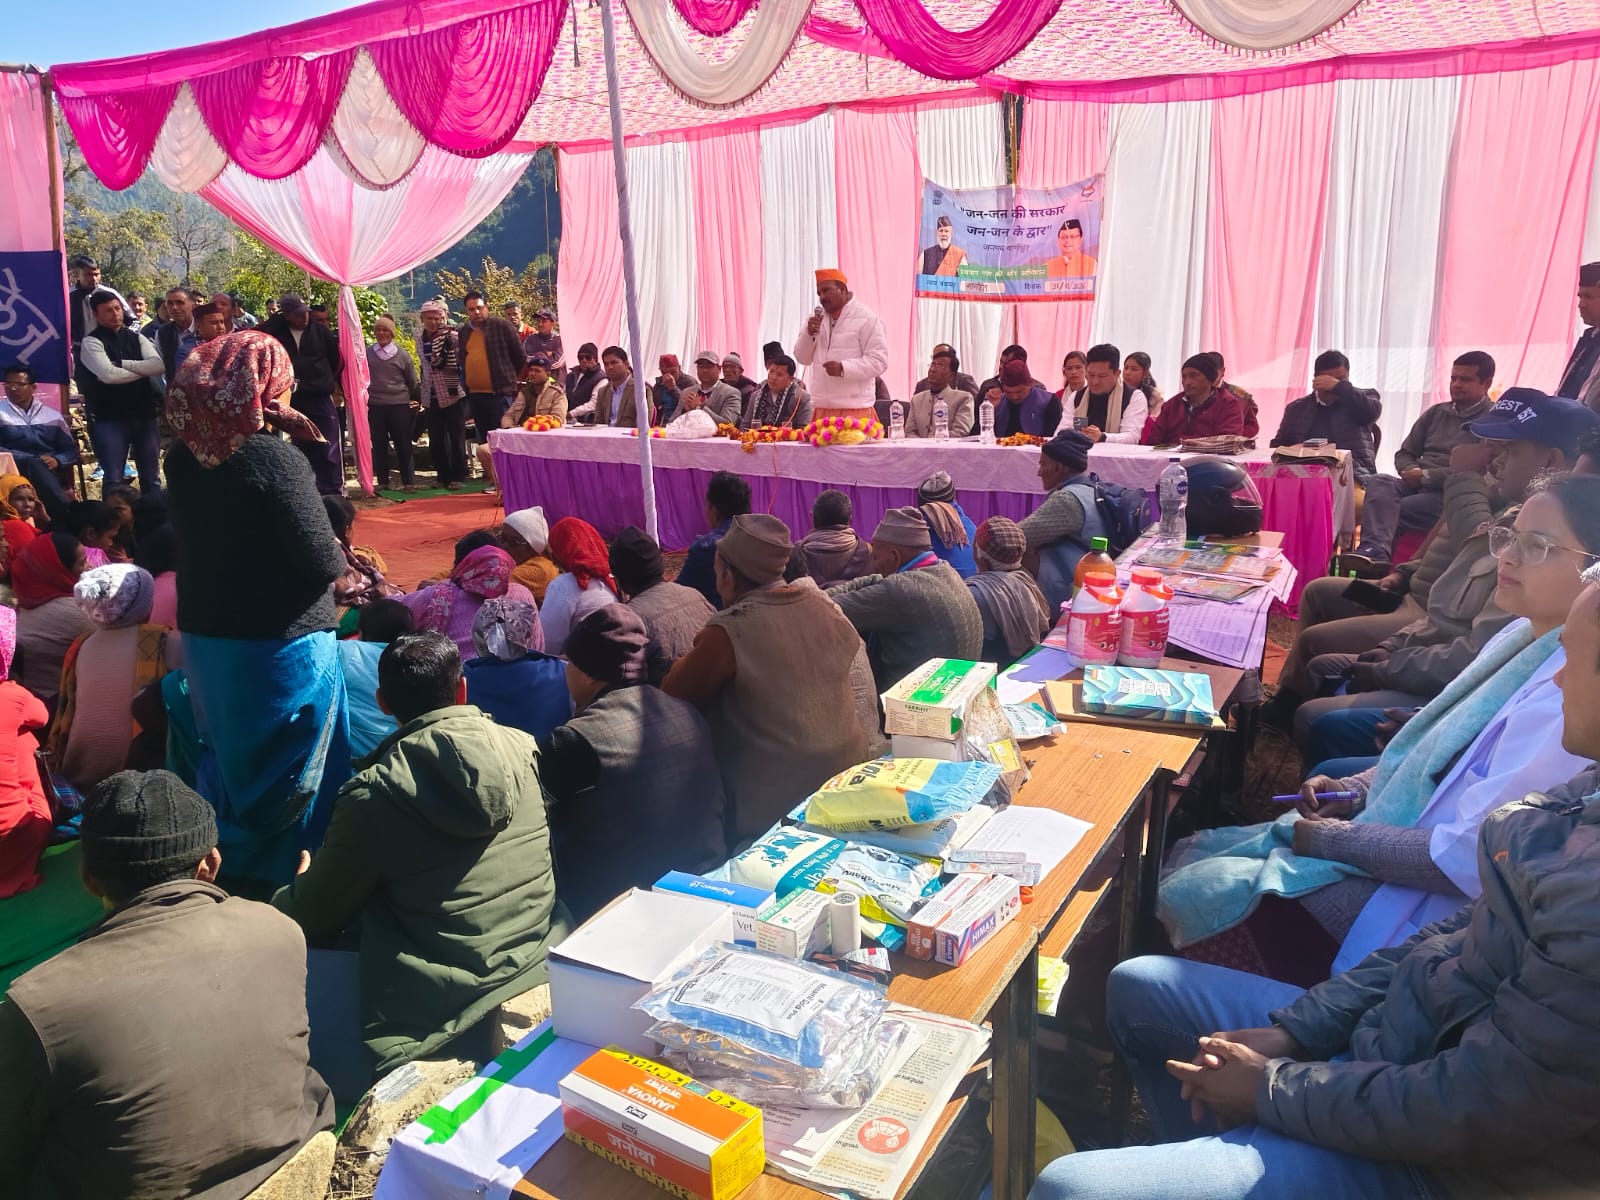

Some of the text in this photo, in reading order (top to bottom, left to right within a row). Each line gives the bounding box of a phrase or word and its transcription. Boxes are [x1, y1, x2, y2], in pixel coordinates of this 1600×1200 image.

[1012, 205, 1026, 219] की
[966, 225, 1009, 237] जन-जन
[1013, 225, 1024, 236] के
[971, 914, 995, 945] HIMAX
[626, 1086, 676, 1113] JANOVA
[606, 1131, 656, 1168] जनोवा
